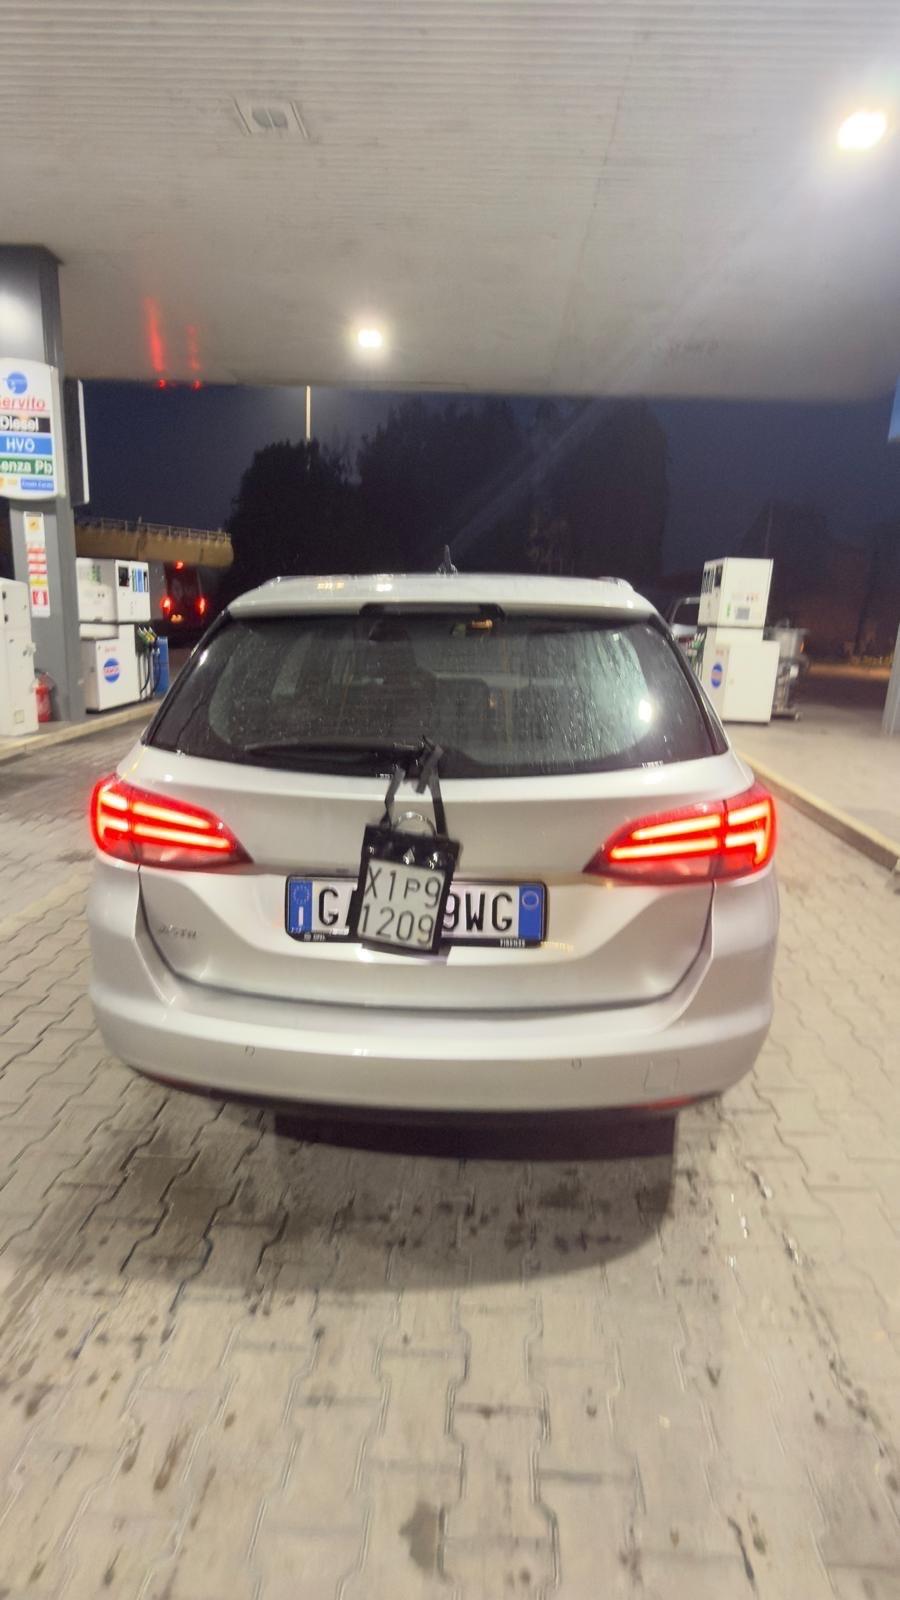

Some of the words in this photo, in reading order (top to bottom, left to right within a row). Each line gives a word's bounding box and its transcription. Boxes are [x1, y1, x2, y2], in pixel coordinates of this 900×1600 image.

[0, 396, 46, 411] ervito
[0, 415, 39, 432] Diesel
[6, 436, 35, 452] HVO
[0, 459, 31, 473] enza
[34, 459, 53, 475] Pb
[362, 903, 434, 944] 1209
